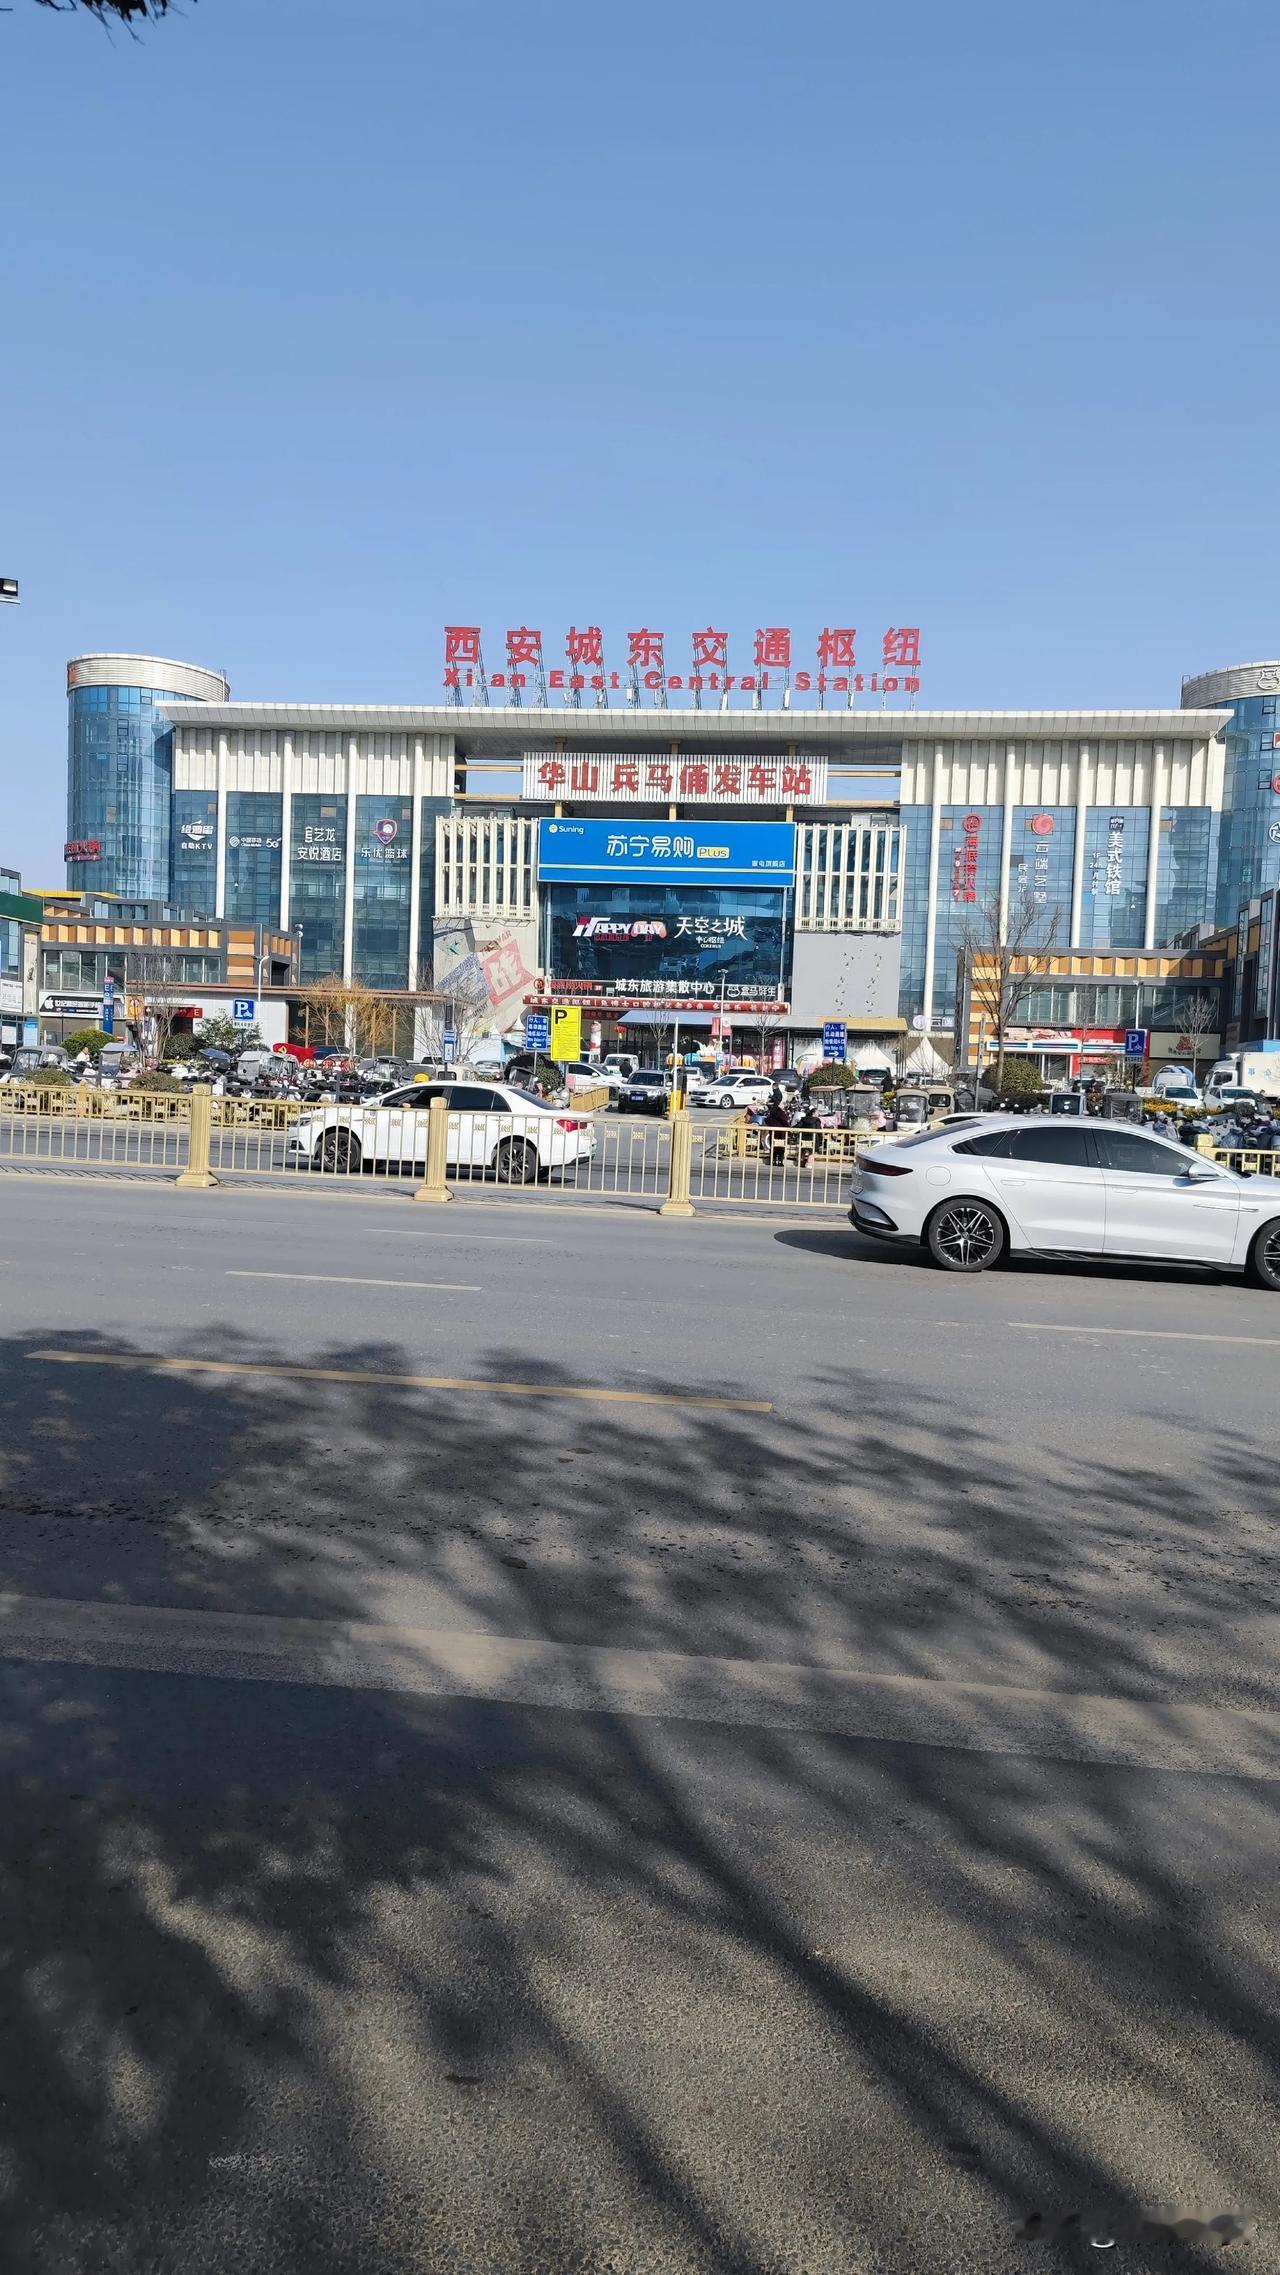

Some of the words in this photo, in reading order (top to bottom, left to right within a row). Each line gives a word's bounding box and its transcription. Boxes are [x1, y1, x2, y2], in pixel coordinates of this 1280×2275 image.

[444, 626, 921, 667] 西安城东交通枢纽
[550, 670, 620, 690] East
[644, 670, 769, 691] Central
[795, 671, 920, 692] Station
[537, 760, 813, 797] 华山兵马俑发车站
[314, 826, 336, 842] 艺龙
[558, 825, 584, 835] Suning
[297, 846, 343, 861] 安悦酒店
[361, 847, 408, 860] 乐优篮球
[606, 834, 695, 858] 苏宁易购
[1104, 831, 1124, 895] 美式铁馆
[673, 915, 749, 941] 天空之城
[614, 978, 715, 995] 城东旅游集散中心
[235, 1001, 249, 1017] P
[554, 1009, 568, 1024] P
[1126, 1033, 1139, 1051] P
